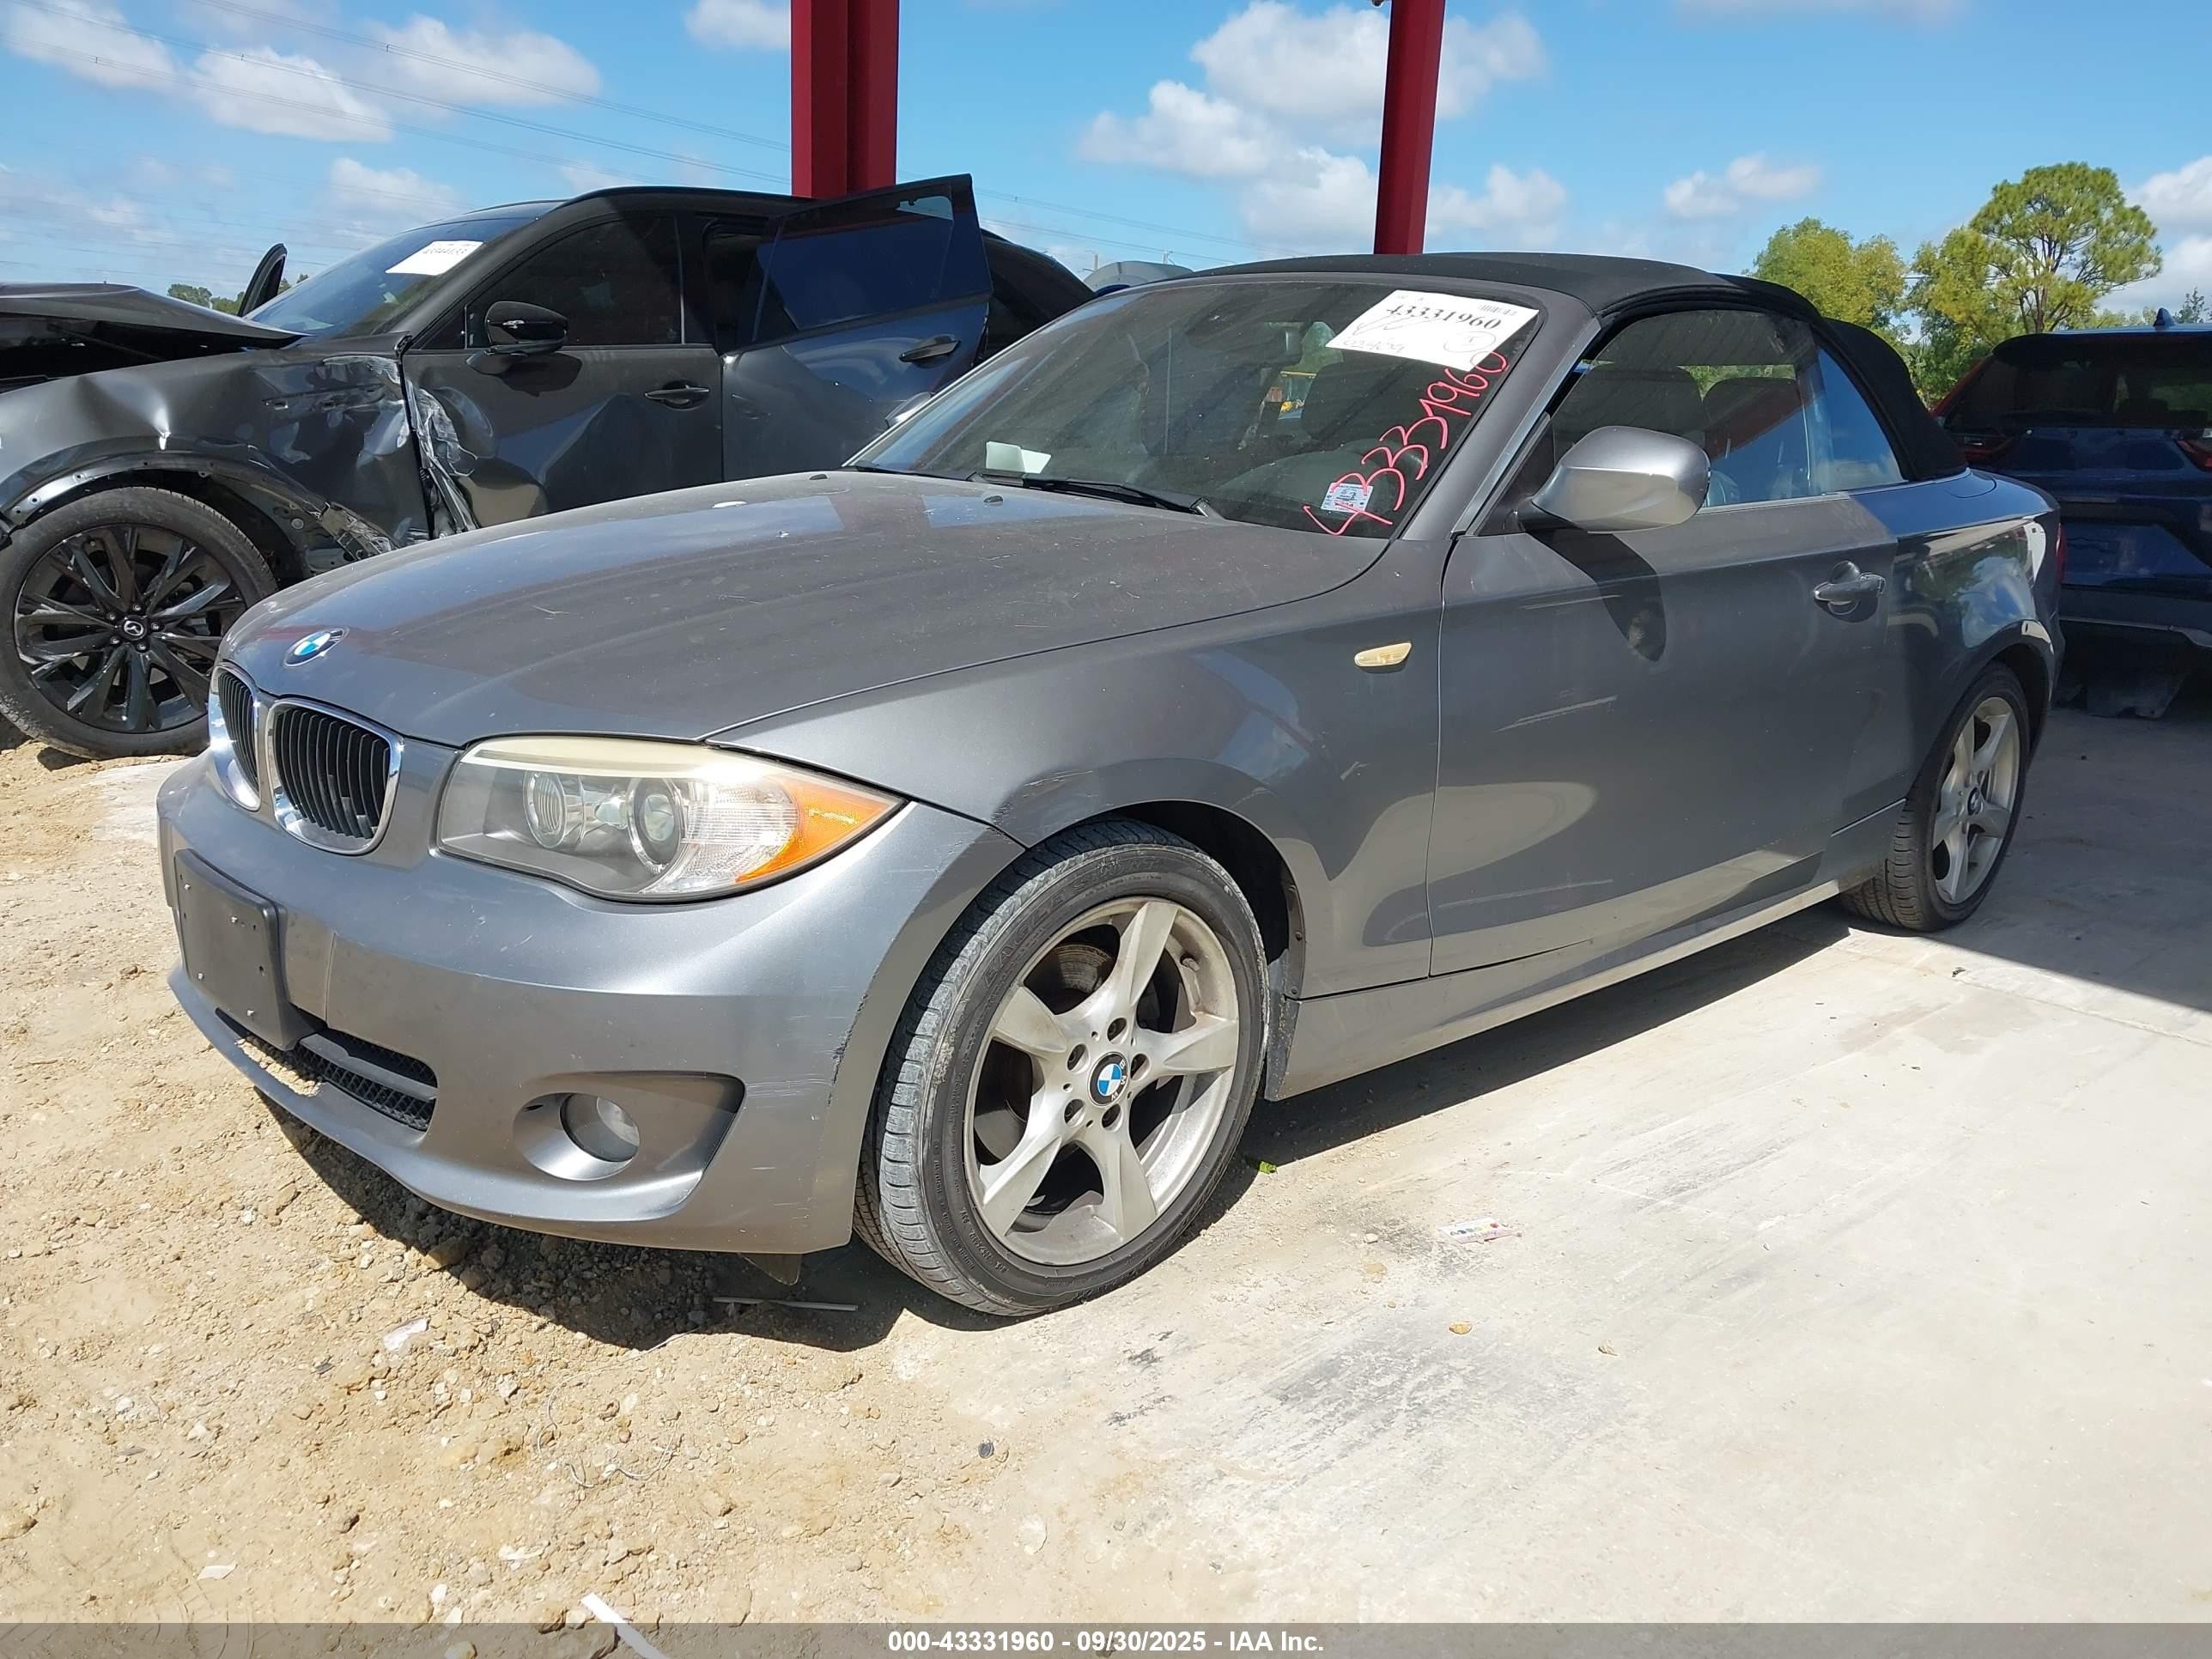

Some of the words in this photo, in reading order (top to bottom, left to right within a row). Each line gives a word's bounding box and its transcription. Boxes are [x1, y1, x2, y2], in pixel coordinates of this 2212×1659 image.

[1386, 304, 1502, 330] 43331960
[1303, 350, 1510, 537] 43331960
[1111, 1058, 1127, 1101] BMW
